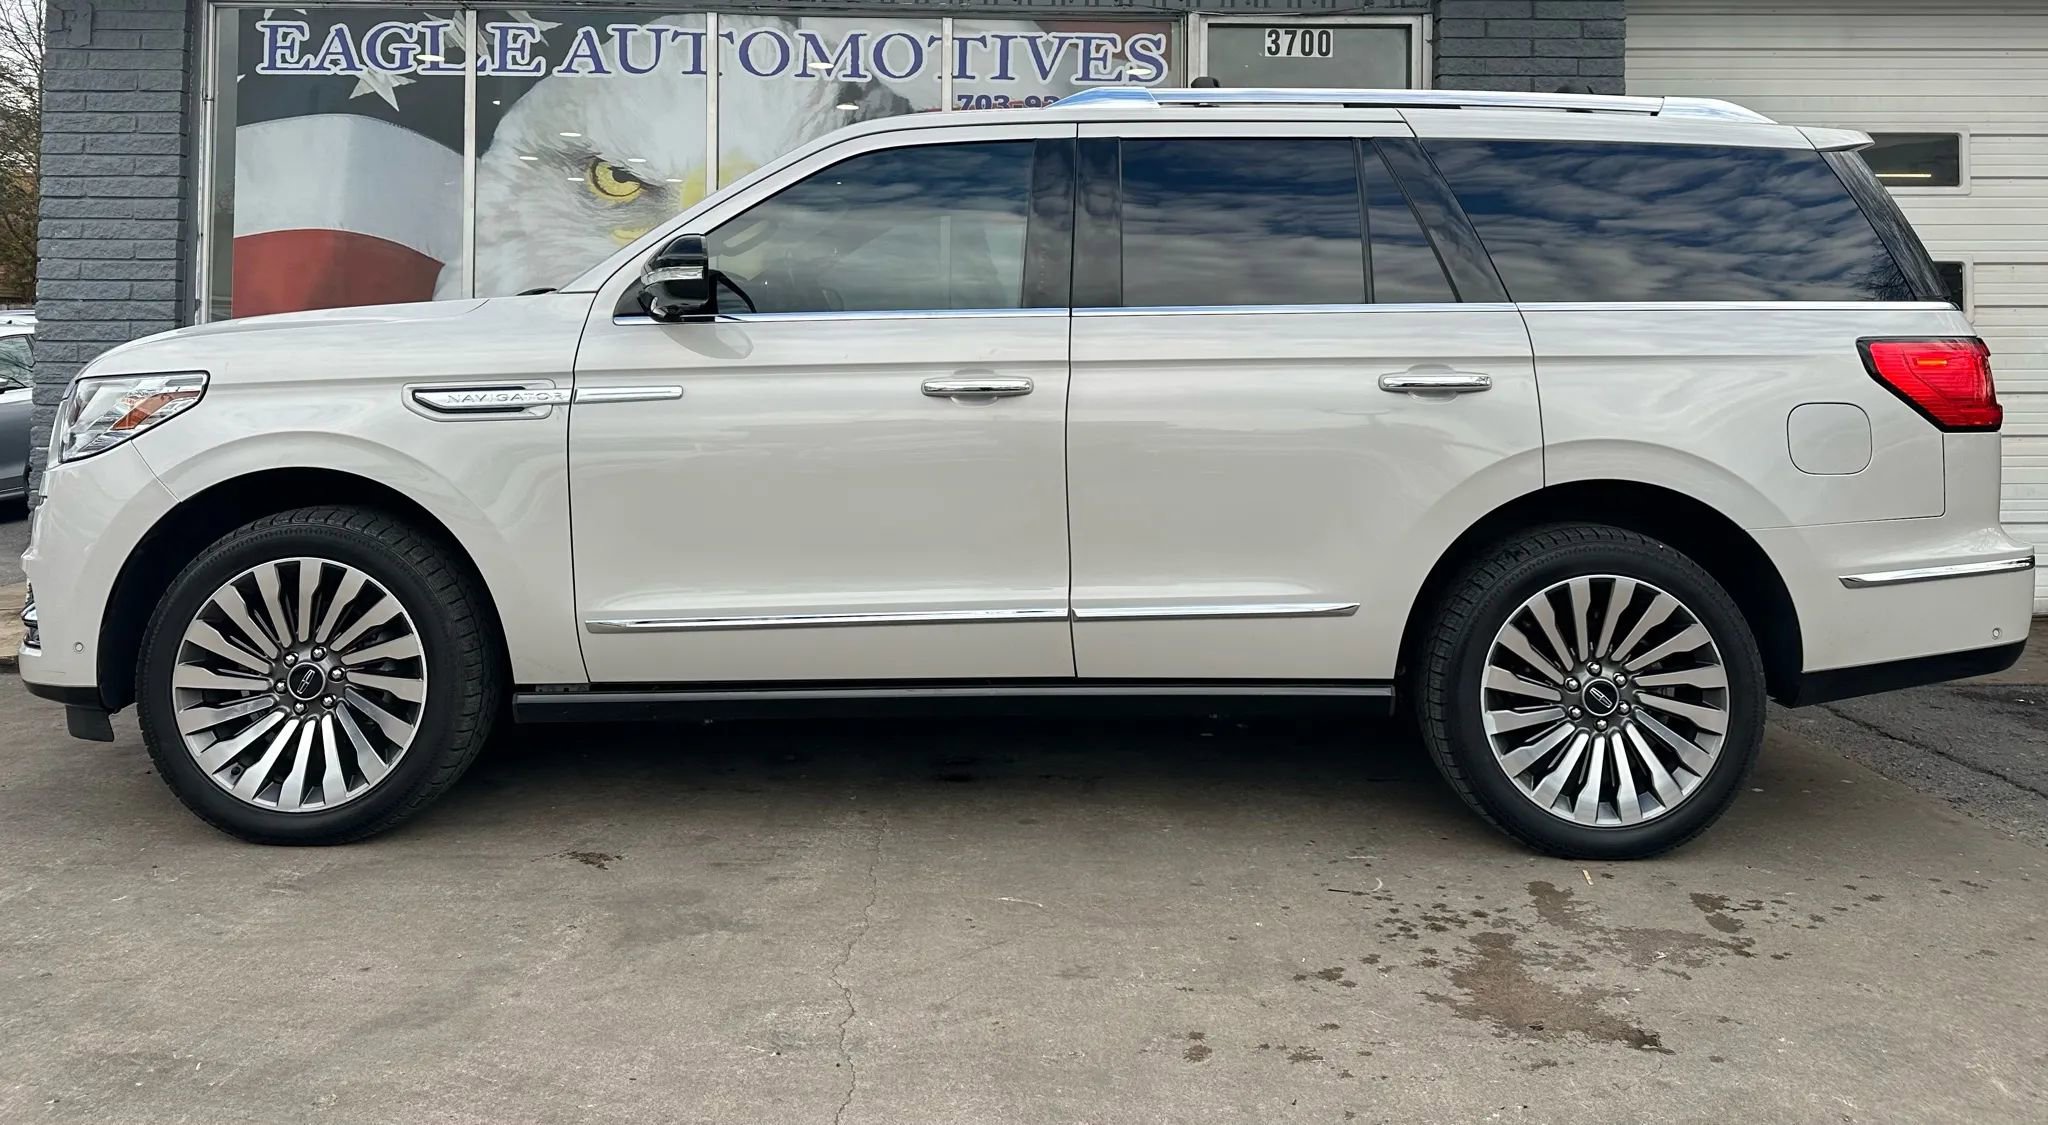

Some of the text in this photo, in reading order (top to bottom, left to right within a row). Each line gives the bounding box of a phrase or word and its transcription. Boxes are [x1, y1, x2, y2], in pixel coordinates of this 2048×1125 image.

[252, 21, 1169, 84] EAGLE AUTOMOTIVES
[1267, 29, 1331, 56] 3700
[447, 392, 564, 403] NAVIGATOR
